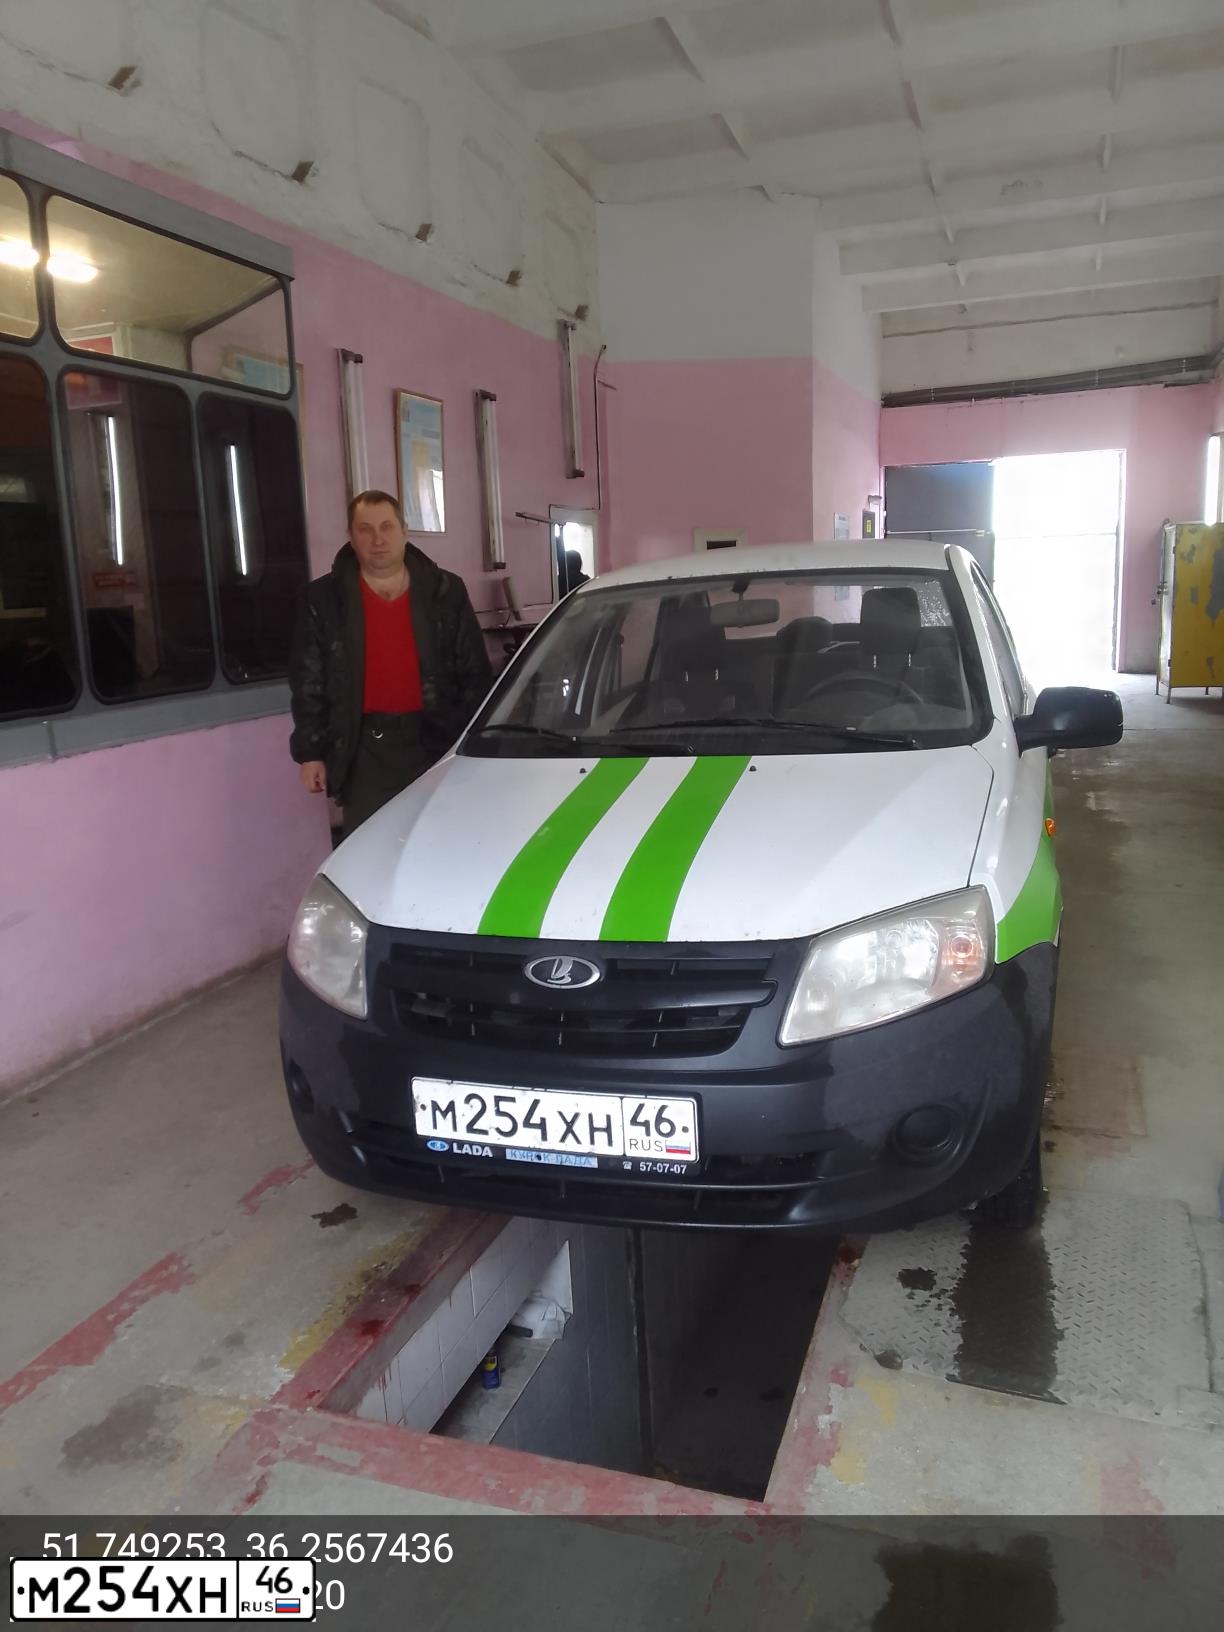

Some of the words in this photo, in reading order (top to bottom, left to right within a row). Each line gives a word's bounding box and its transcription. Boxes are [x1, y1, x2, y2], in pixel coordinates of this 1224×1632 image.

[630, 1102, 676, 1138] 46
[452, 1142, 493, 1158] LADA
[629, 1138, 663, 1152] RUS
[639, 1161, 687, 1175] 57-07-07
